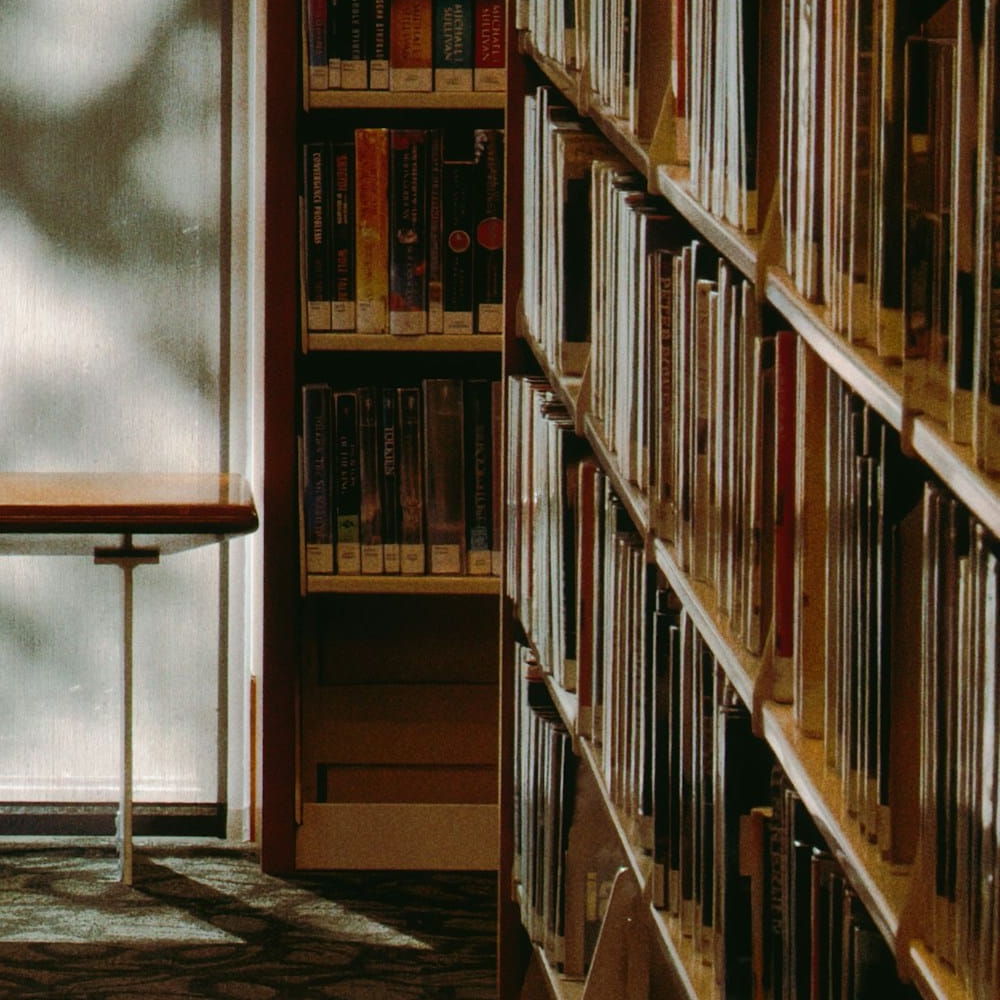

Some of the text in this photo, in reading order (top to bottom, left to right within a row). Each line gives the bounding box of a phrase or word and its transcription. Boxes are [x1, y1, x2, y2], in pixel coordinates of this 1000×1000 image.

[443, 8, 453, 62] SULLIVAN
[454, 4, 463, 54] MICHAEL
[481, 8, 491, 62] SULLIVAN
[492, 5, 501, 55] MICHAEL
